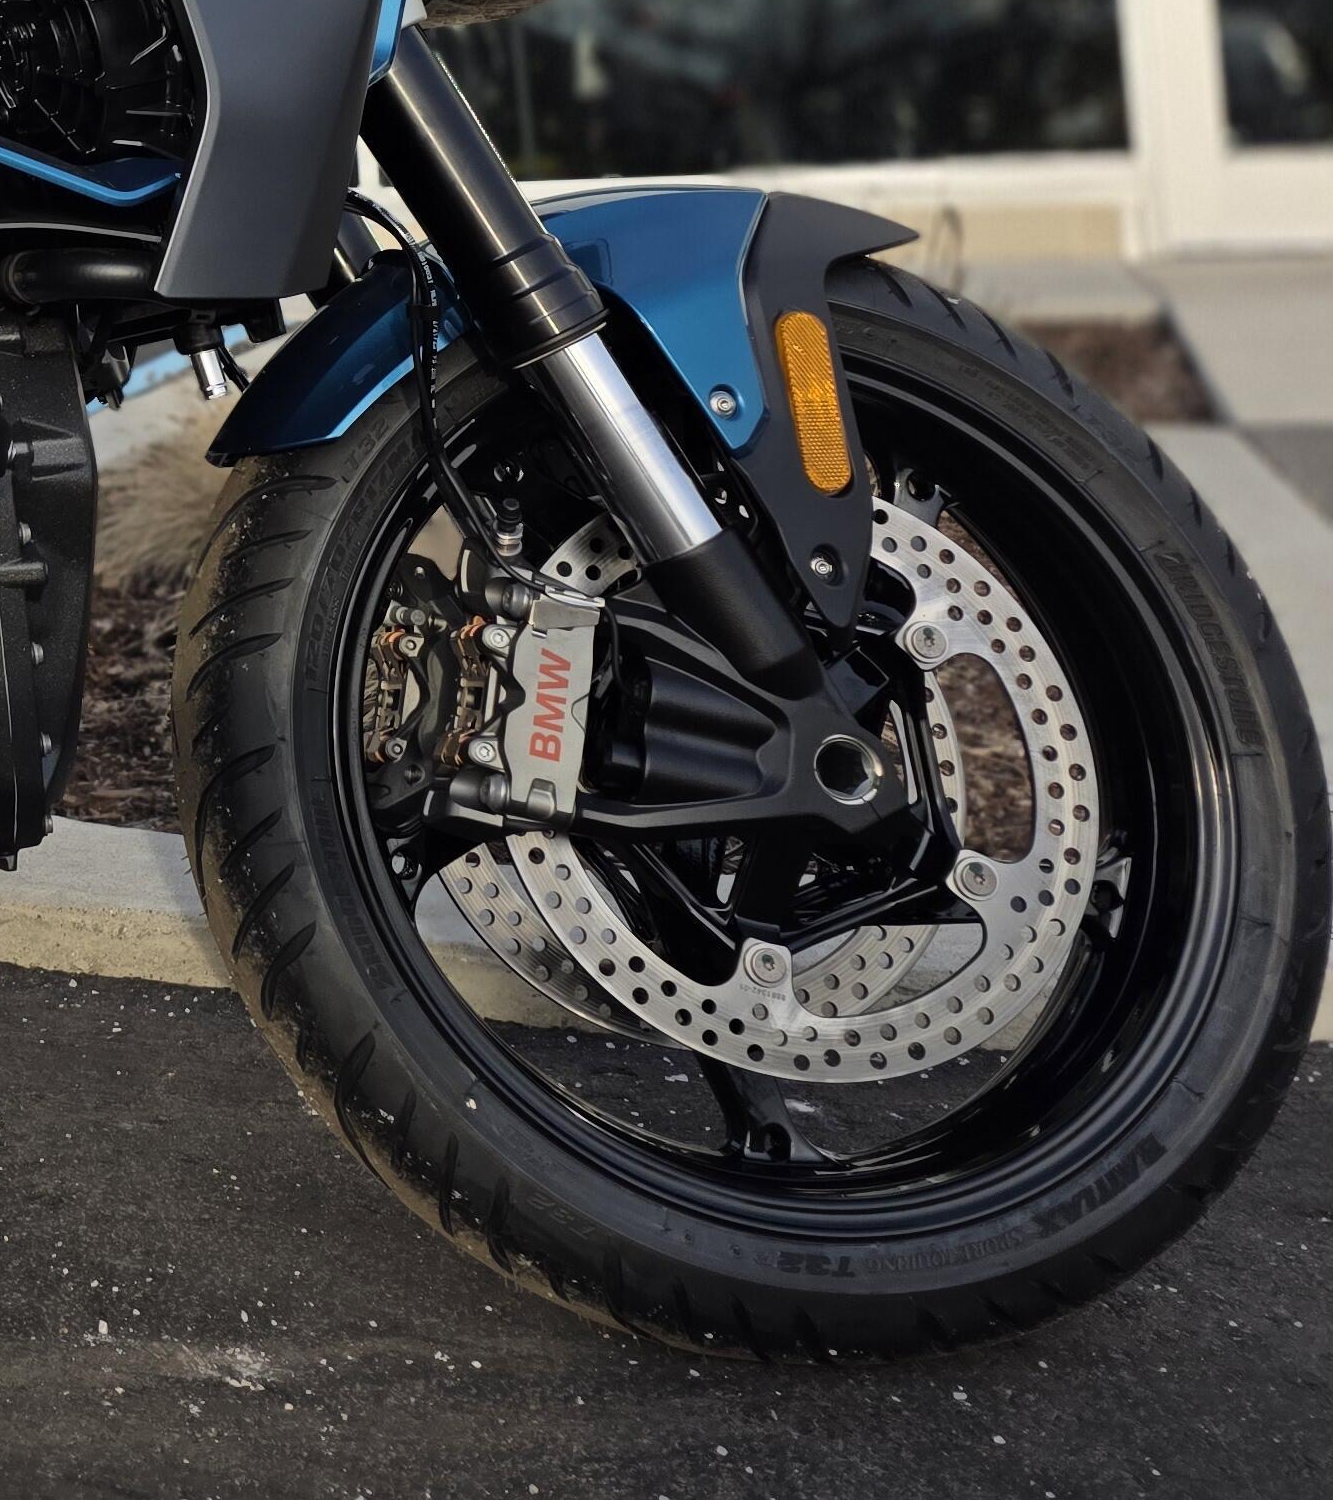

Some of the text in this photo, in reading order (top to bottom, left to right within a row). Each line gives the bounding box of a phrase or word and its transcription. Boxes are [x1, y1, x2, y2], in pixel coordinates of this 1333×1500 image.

[529, 647, 572, 762] BMW
[1154, 551, 1267, 748] BRIDGESTONE
[777, 1250, 857, 1279] T32
